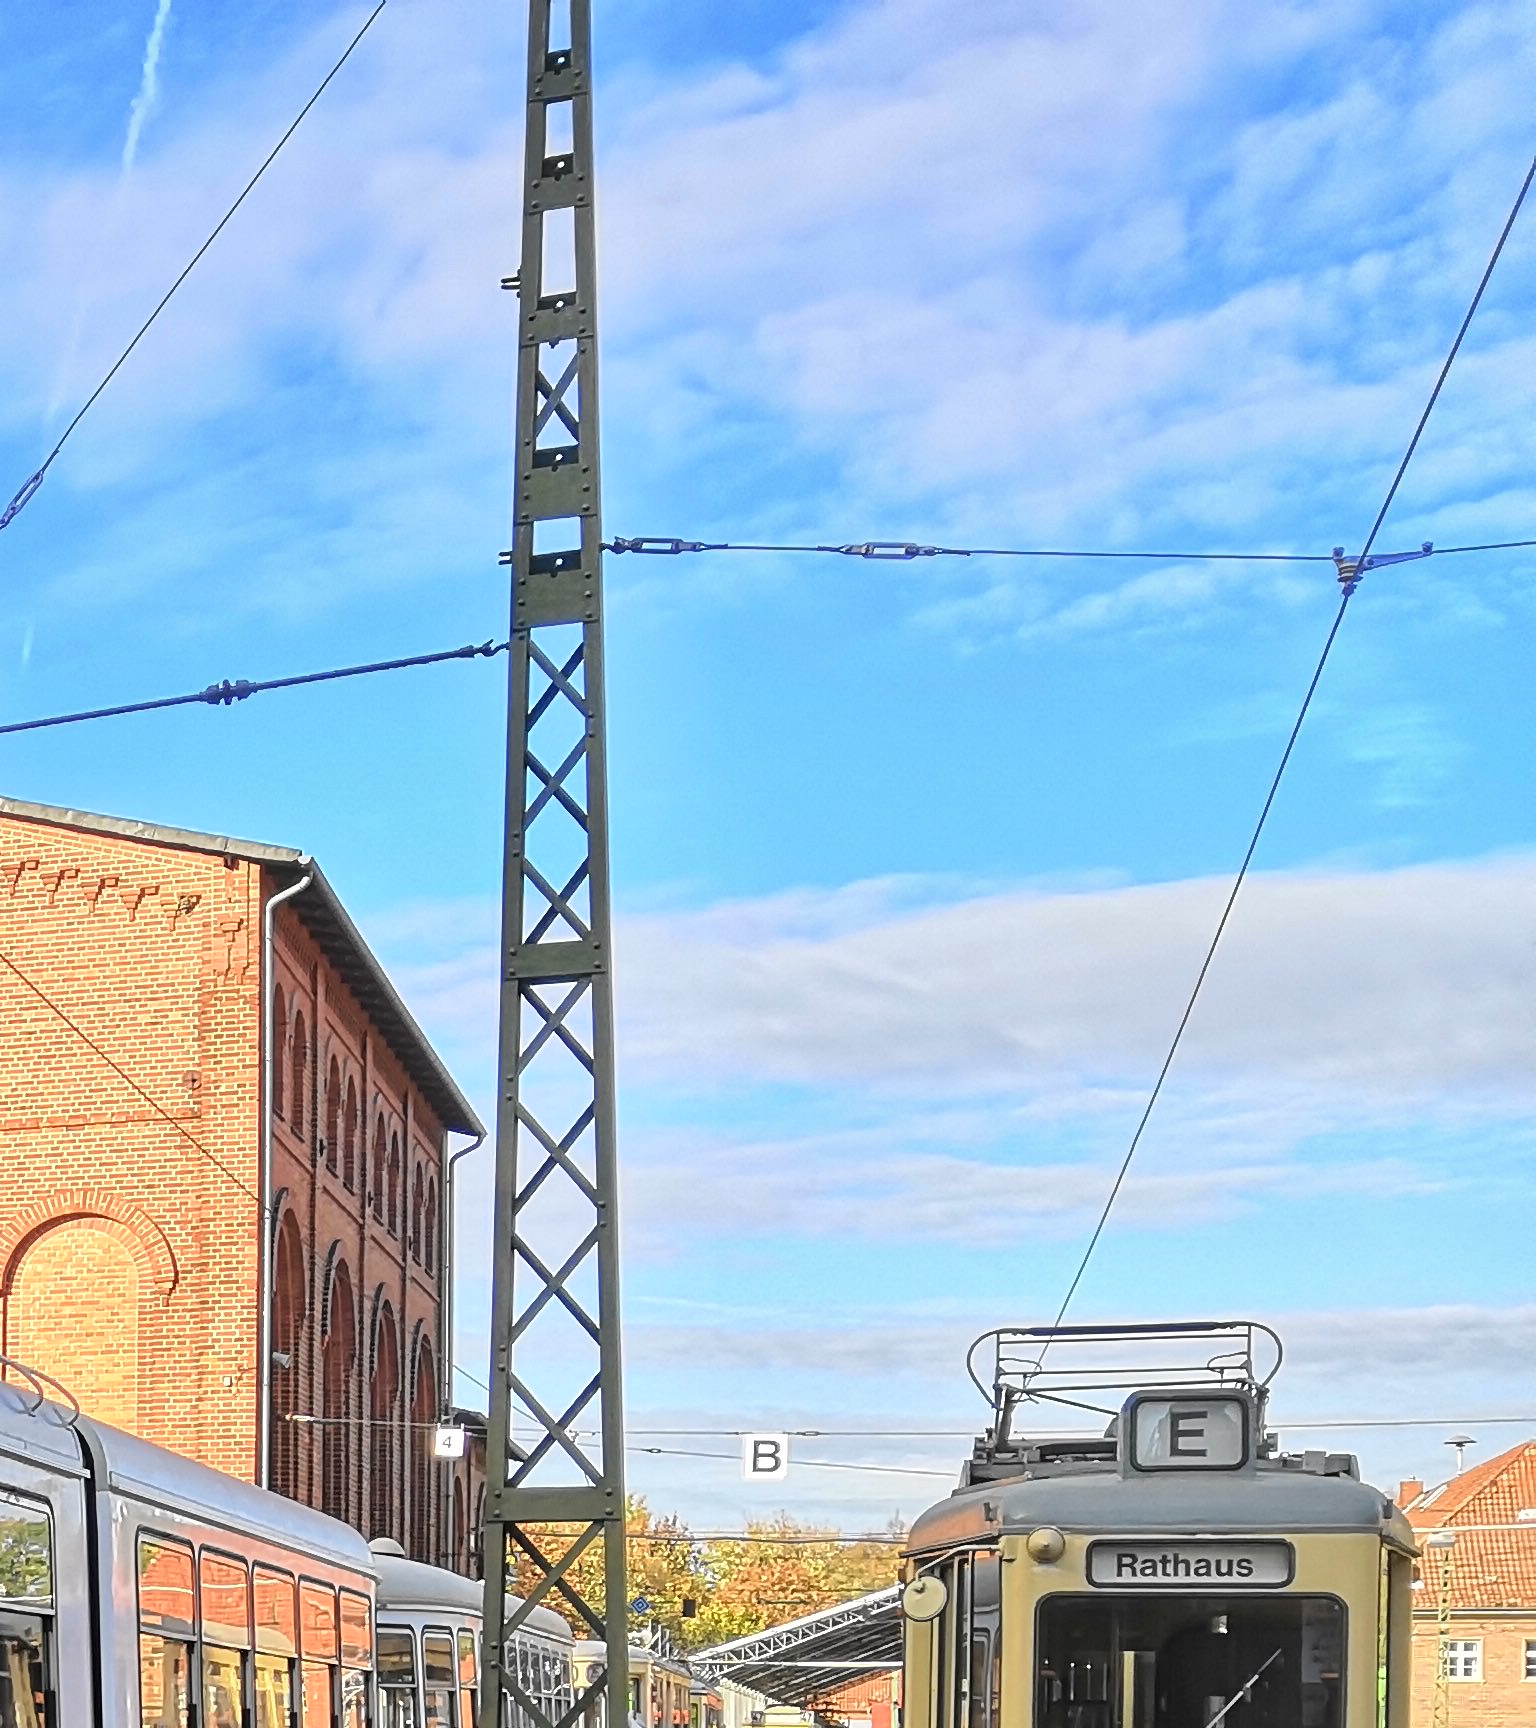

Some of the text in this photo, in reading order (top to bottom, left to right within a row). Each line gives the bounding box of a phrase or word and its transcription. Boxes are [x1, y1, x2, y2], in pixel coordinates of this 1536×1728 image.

[442, 1436, 452, 1449] 4
[1169, 1410, 1209, 1458] E
[752, 1440, 782, 1473] B
[1115, 1552, 1254, 1578] Rathaus
